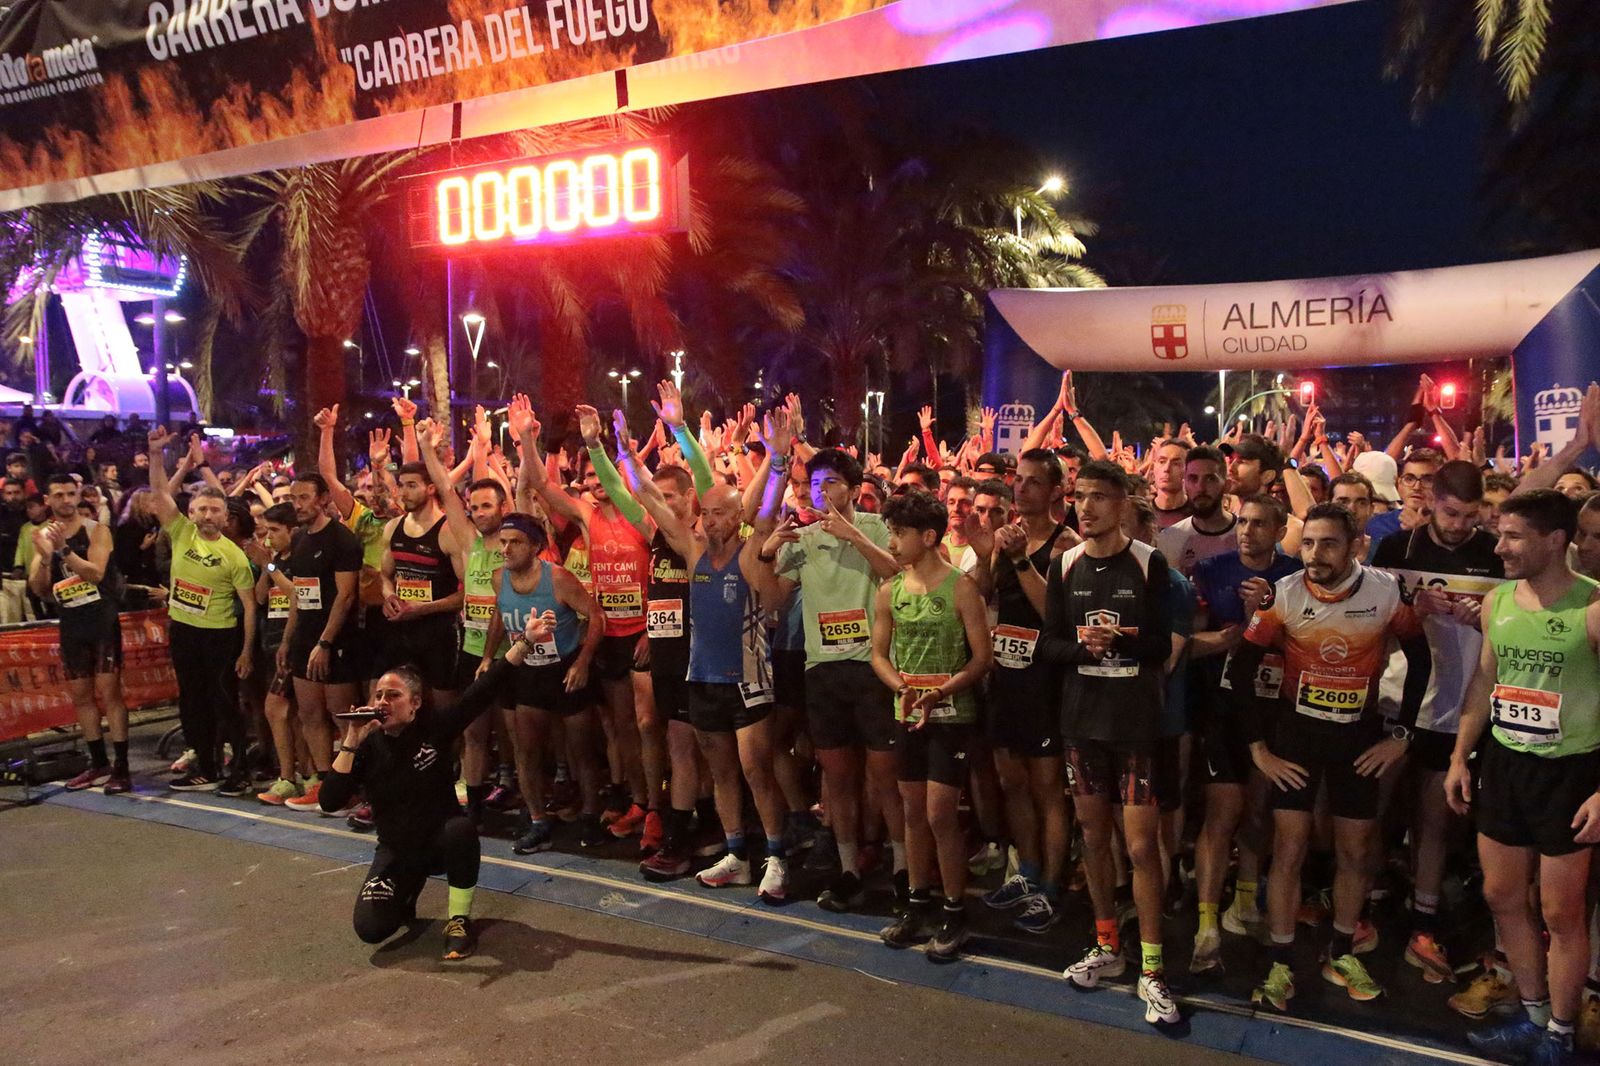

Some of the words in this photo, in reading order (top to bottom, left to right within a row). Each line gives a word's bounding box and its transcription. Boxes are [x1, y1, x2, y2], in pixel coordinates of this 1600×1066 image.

[484, 5, 544, 63] DEL
[546, 0, 650, 50] FUEGO
[0, 38, 99, 90] dolameta
[1222, 289, 1394, 331] ALMERÍA
[1222, 334, 1308, 354] CIUDAD
[614, 560, 637, 571] CAMÍ
[64, 583, 90, 596] 2342
[179, 589, 204, 604] 2680
[402, 588, 426, 598] 2343
[606, 594, 634, 604] 2620
[470, 605, 494, 615] 2576
[652, 611, 677, 624] 364
[826, 622, 861, 636] 2659
[999, 637, 1029, 655] 155
[1497, 644, 1564, 664] Universo
[1509, 659, 1562, 677] Running
[1313, 689, 1359, 704] 2609
[1509, 704, 1541, 722] 513
